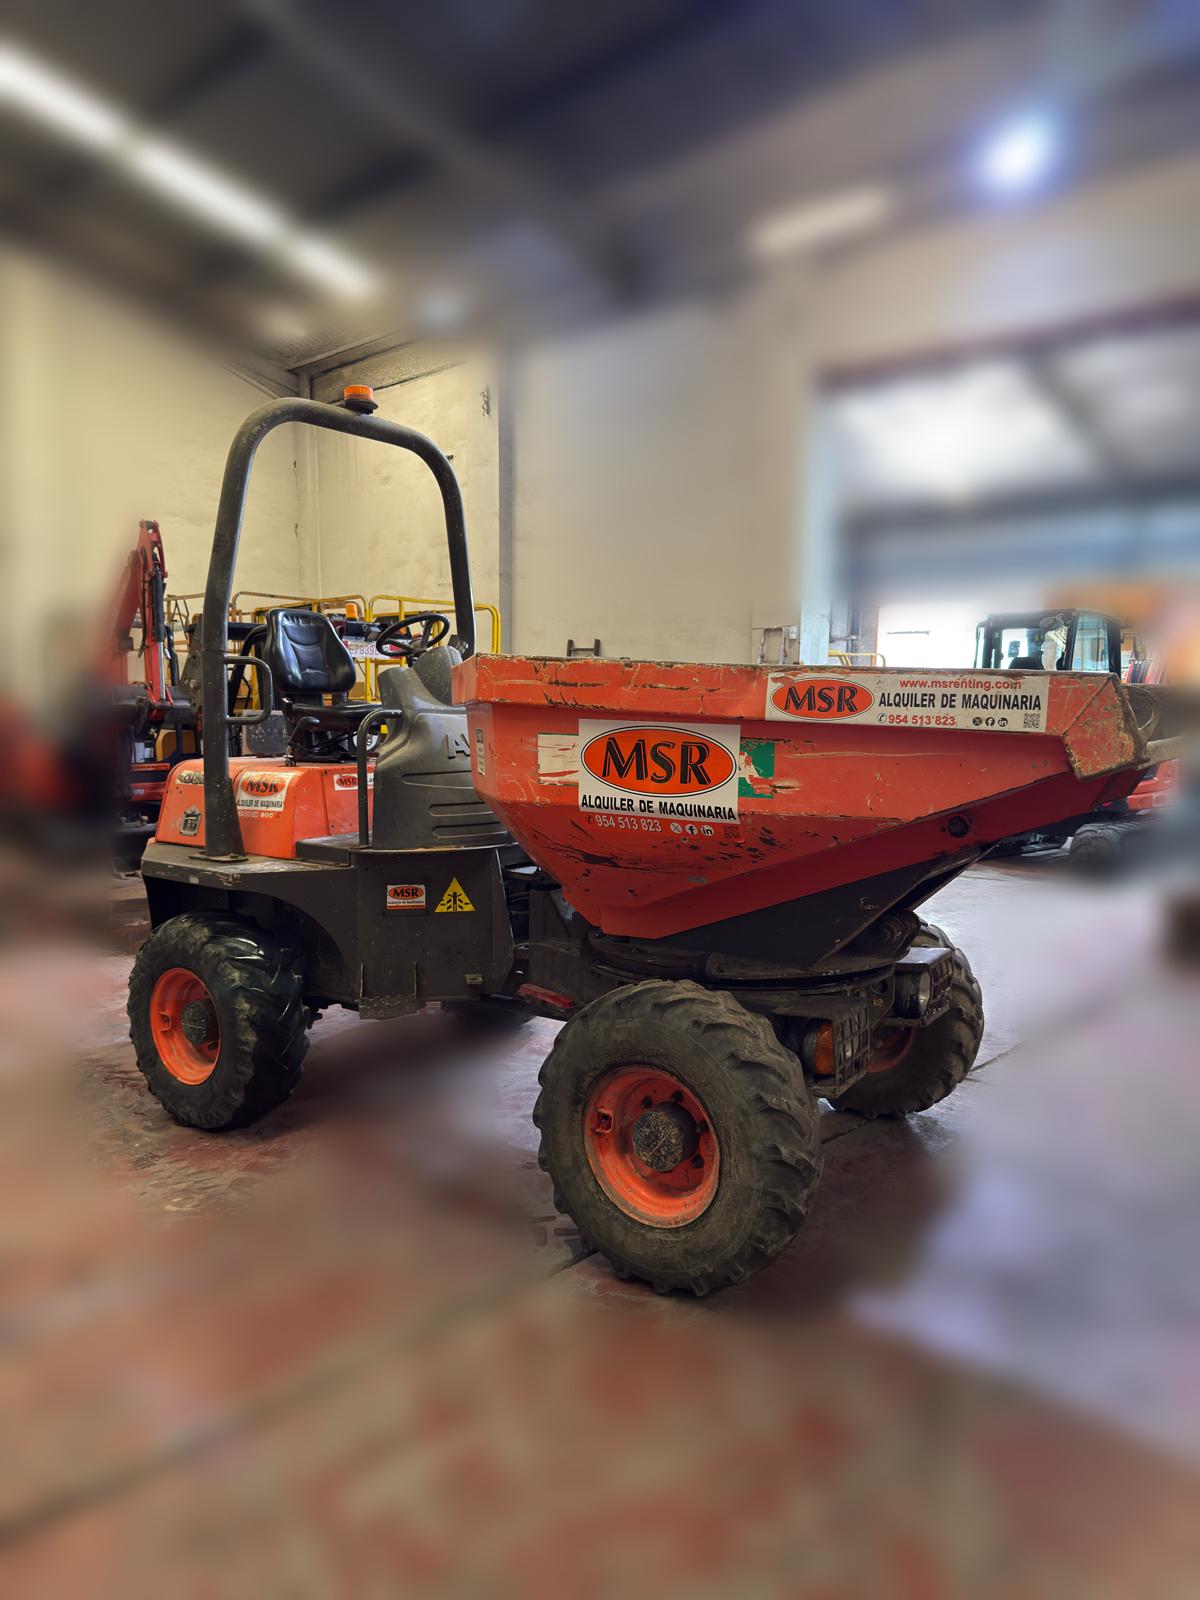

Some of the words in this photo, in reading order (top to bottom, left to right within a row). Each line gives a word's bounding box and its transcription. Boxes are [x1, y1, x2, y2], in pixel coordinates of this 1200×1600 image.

[899, 679, 1022, 691] www.msrenting.com
[784, 685, 858, 713] MSR
[878, 692, 936, 709] ALQUILER
[940, 693, 957, 709] DE
[961, 693, 1042, 710] MAQUINARIA
[888, 714, 909, 724] 954
[911, 715, 932, 725] 513
[935, 716, 955, 726] 823
[602, 736, 712, 786] MSR
[246, 780, 279, 793] MSR
[339, 777, 358, 787] MSR
[581, 794, 635, 812] ALQUILER
[639, 799, 655, 814] DE
[659, 801, 737, 821] MAQUINARIA
[595, 814, 616, 829] 954
[618, 816, 639, 831] 513
[640, 818, 662, 832] 823
[393, 887, 418, 898] MSR
